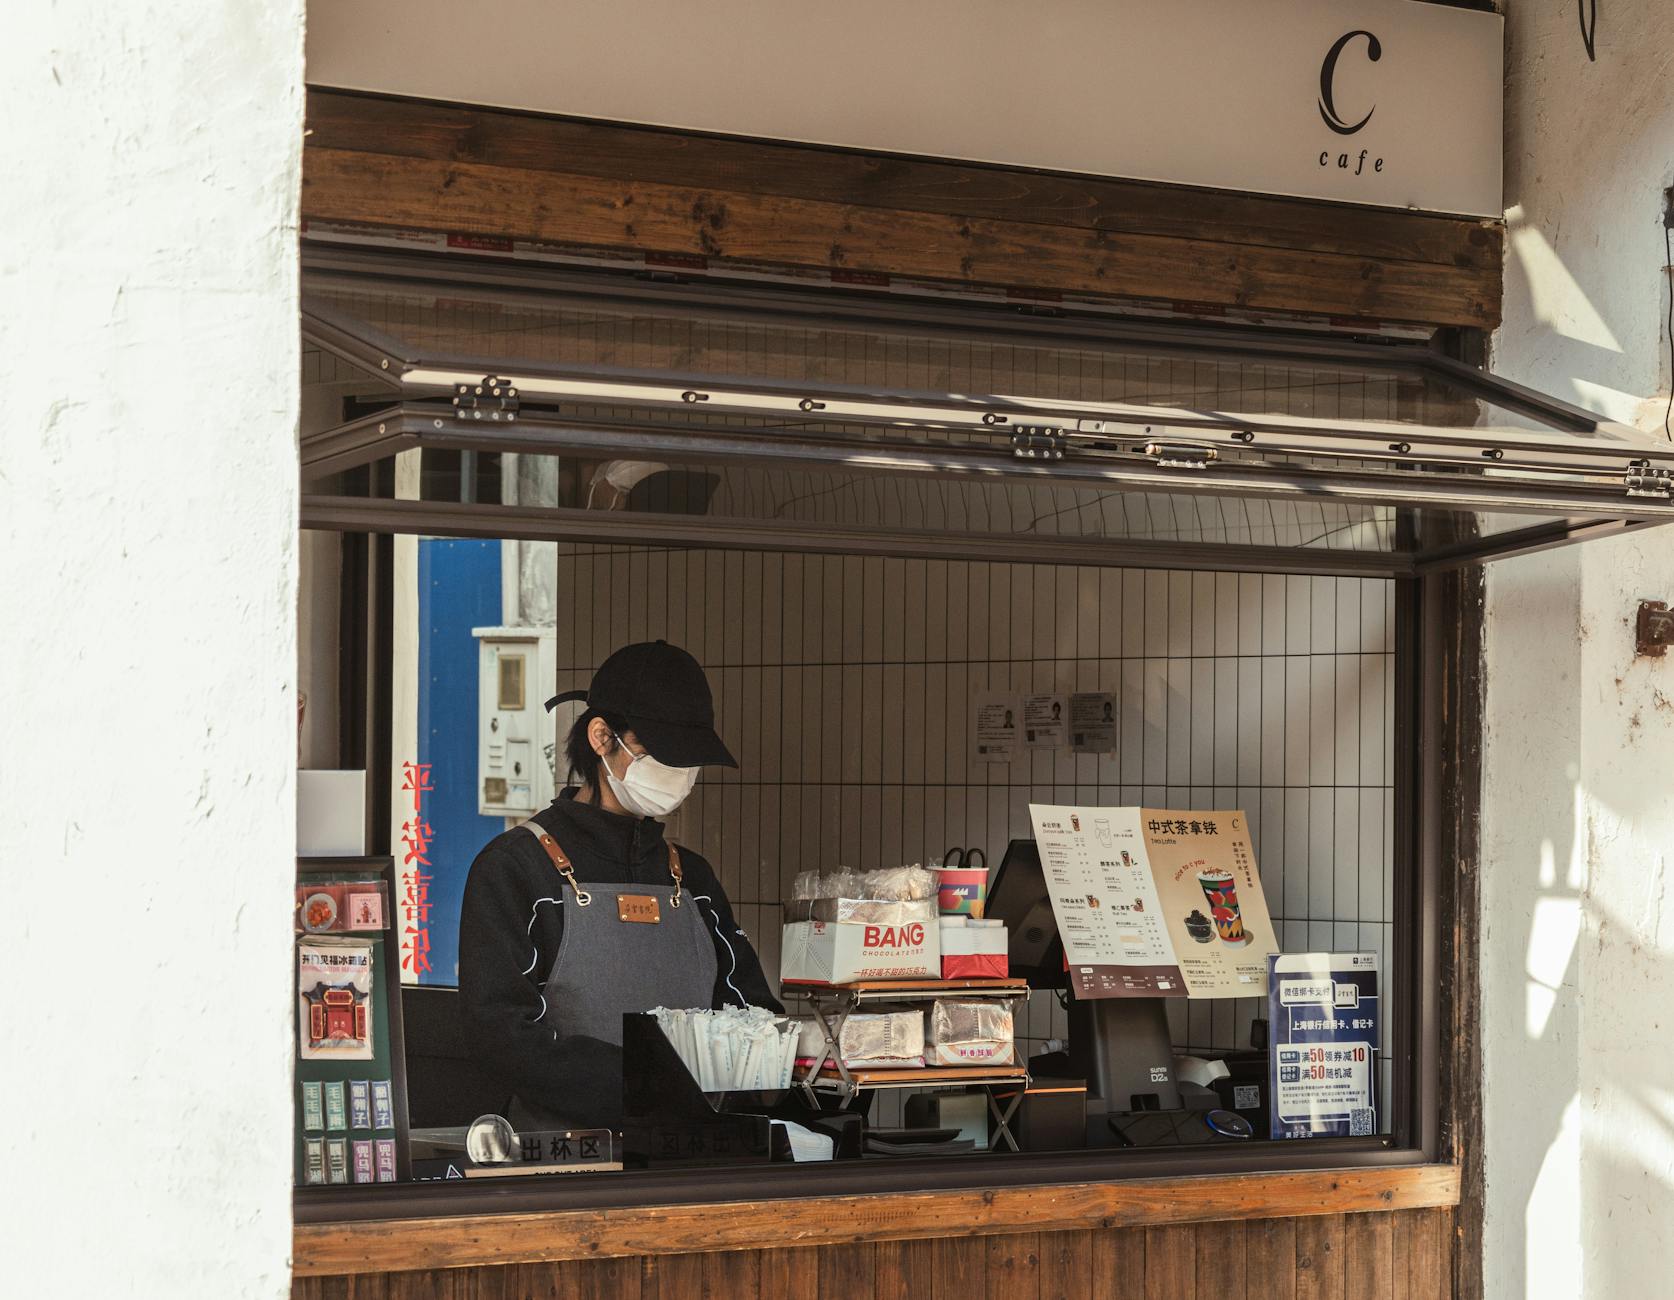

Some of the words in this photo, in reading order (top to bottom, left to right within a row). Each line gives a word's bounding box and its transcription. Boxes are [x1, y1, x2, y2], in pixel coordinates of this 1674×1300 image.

[1318, 30, 1382, 135] C
[1319, 149, 1383, 176] cafe
[1148, 819, 1219, 836] 中式茶拿铁
[1193, 859, 1205, 868] you
[863, 923, 925, 948] BANG
[853, 965, 928, 977] 一杯好喝不甜的巧克力
[1284, 987, 1330, 997] 微信绑卡支付
[1292, 1019, 1374, 1031] 上海银行信用卡、借记卡
[1301, 1047, 1365, 1063] 满50领券减10
[1301, 1065, 1353, 1081] 满50随机减
[521, 1134, 600, 1162] 出杯区
